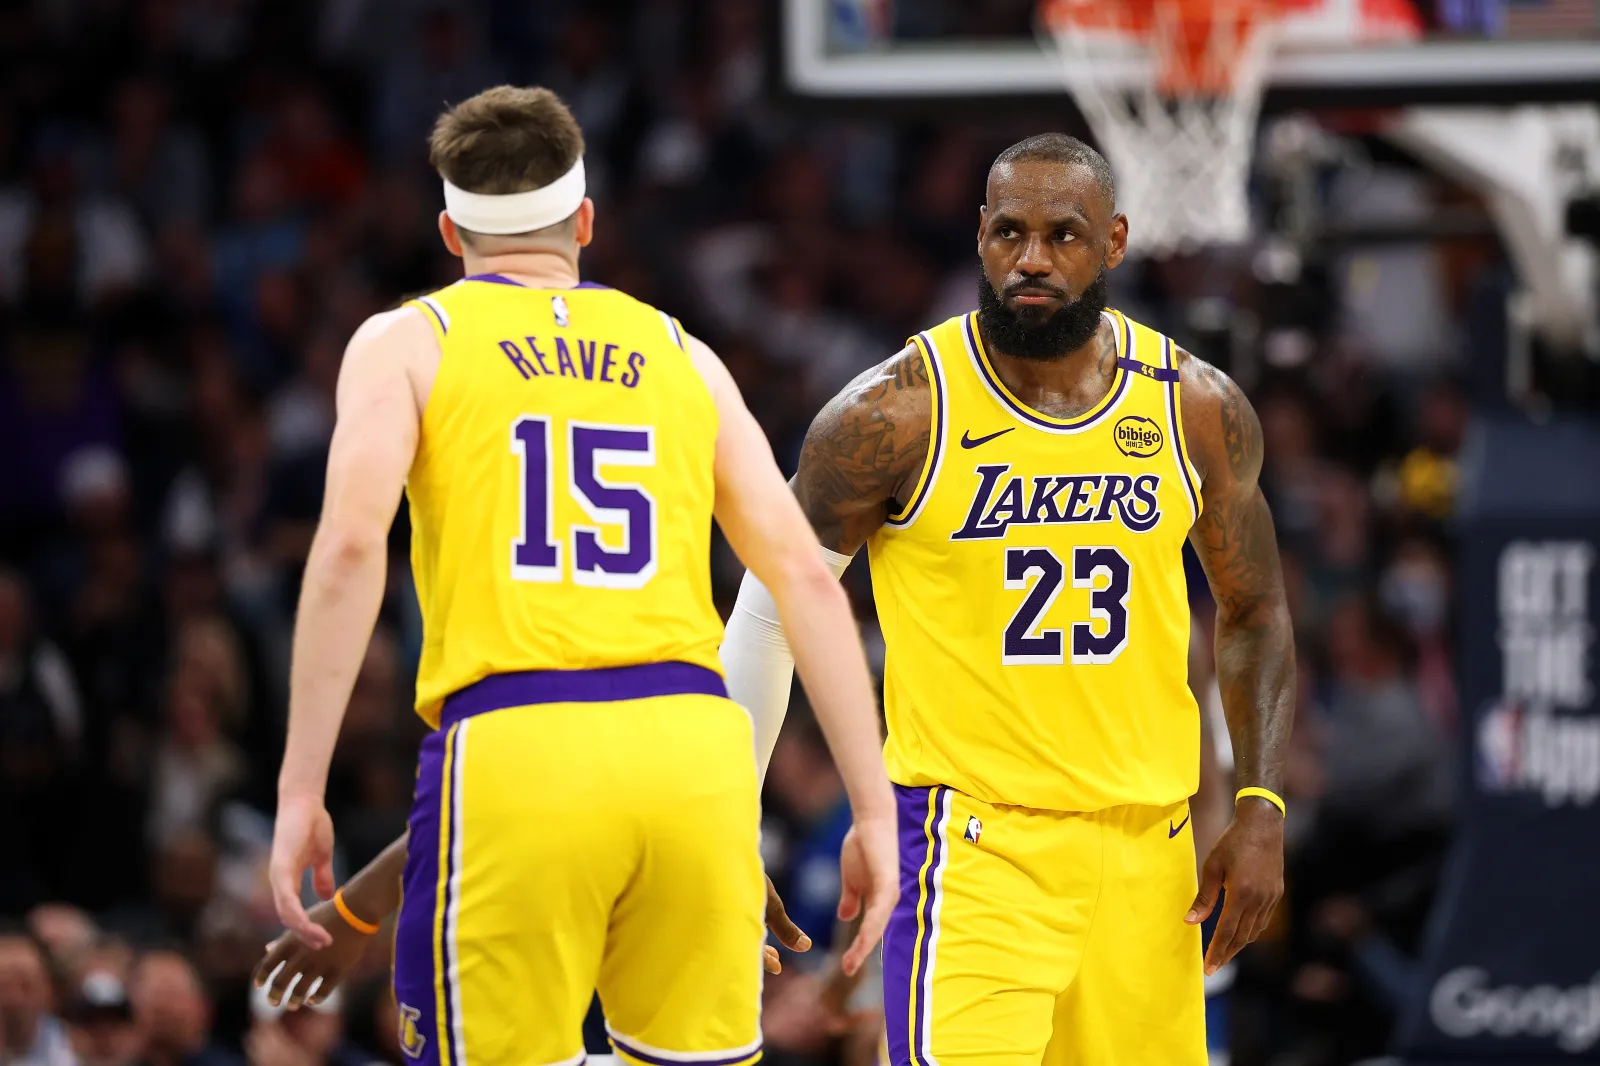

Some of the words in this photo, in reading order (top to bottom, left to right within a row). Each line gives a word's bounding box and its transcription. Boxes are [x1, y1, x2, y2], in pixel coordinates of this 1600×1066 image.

[498, 336, 646, 389] REAVES
[1141, 365, 1154, 377] 44
[1118, 426, 1160, 446] bibigo
[510, 413, 658, 590] 15
[949, 463, 1162, 541] LAKERS
[1002, 545, 1133, 666] 23
[1499, 541, 1591, 616] GET
[1499, 621, 1591, 706] THE
